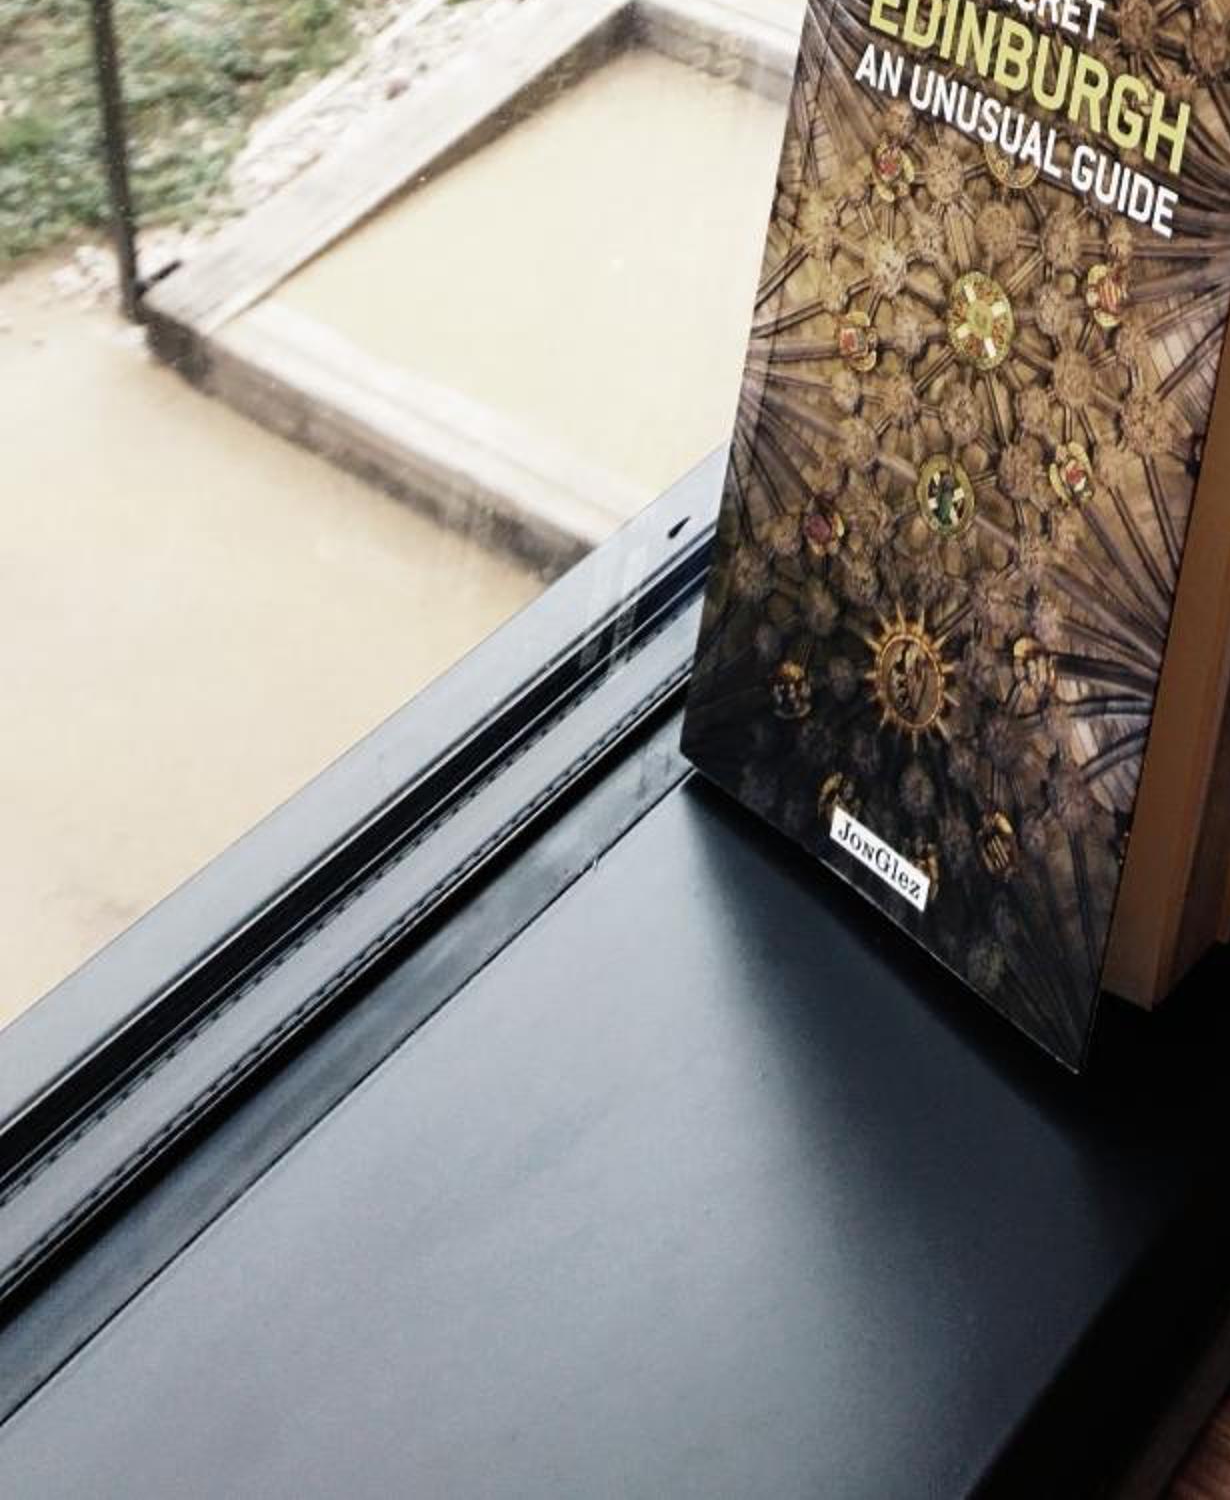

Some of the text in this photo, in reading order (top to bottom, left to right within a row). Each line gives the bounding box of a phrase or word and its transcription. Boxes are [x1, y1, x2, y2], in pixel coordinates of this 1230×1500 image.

[854, 43, 1180, 238] AN UNUSUAL GUIDE
